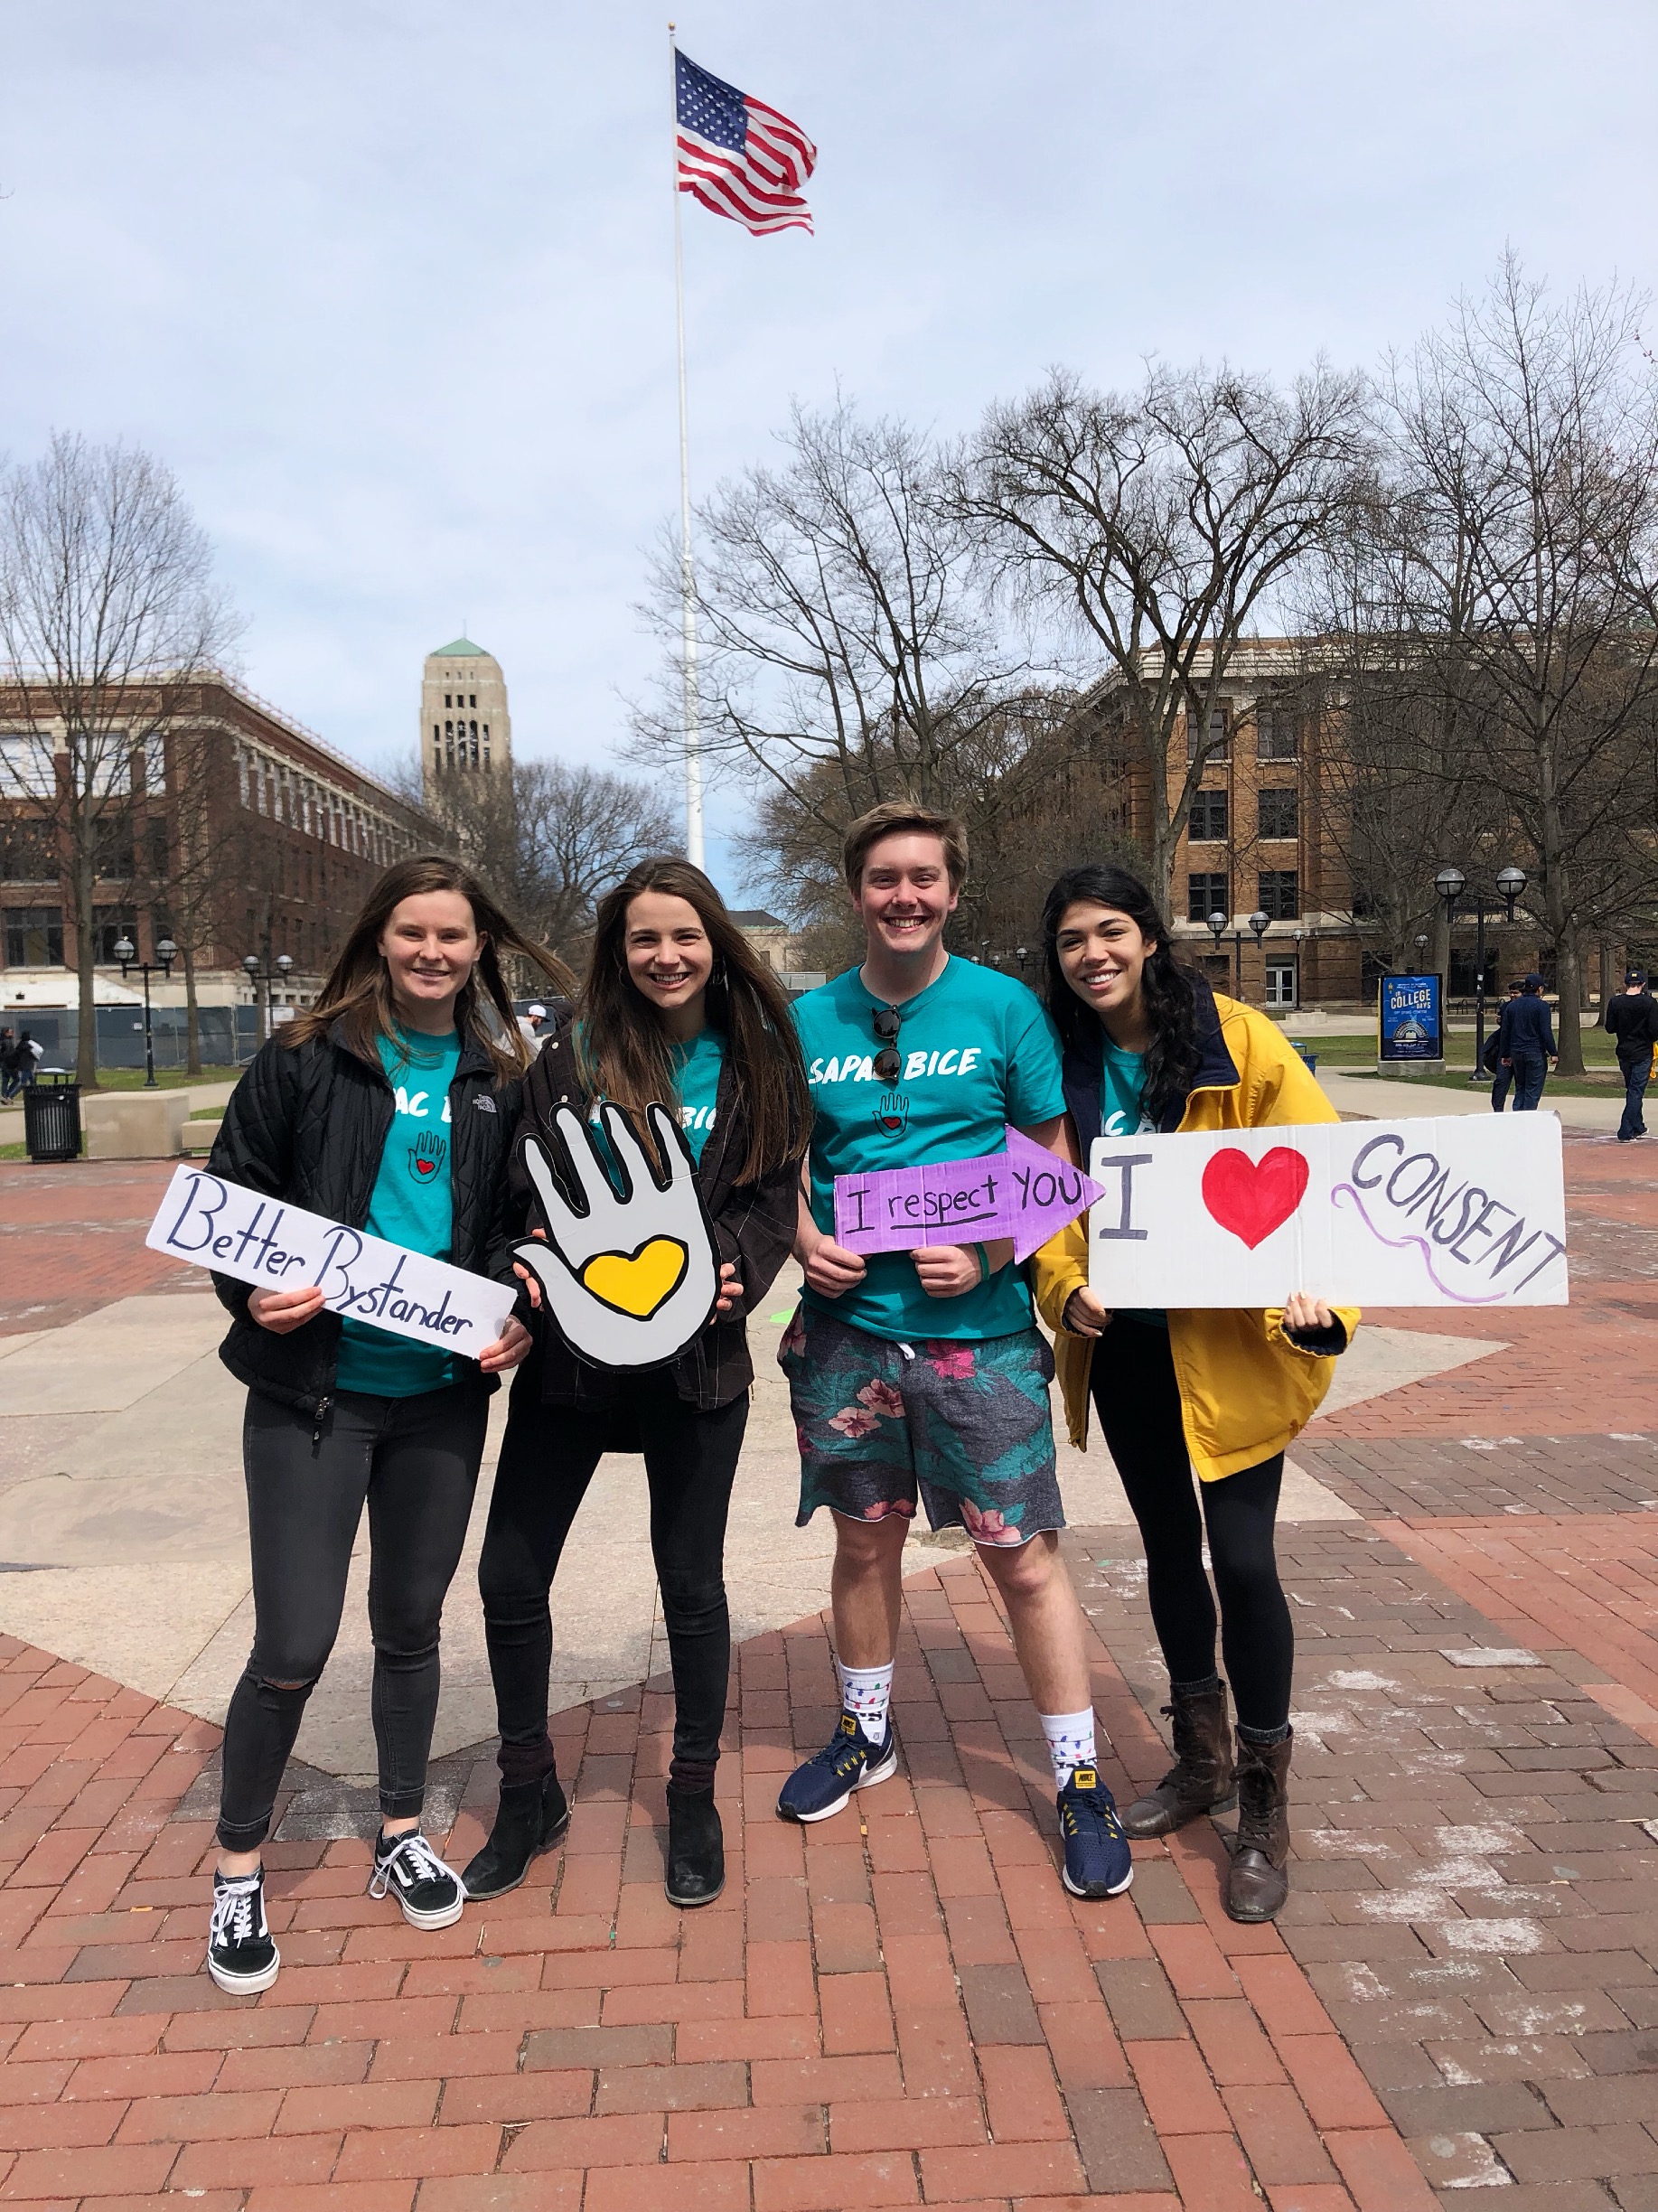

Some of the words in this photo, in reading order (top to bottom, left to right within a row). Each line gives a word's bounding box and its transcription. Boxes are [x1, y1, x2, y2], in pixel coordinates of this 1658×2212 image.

[1391, 989, 1430, 1009] COLLEGE
[808, 1055, 886, 1084] SAPA
[904, 1047, 981, 1080] BICE
[845, 1189, 875, 1234] I
[888, 1175, 998, 1223] respect
[1012, 1167, 1082, 1211] YOU
[1099, 1153, 1153, 1240] I
[1351, 1133, 1567, 1294] CONSENT
[167, 1173, 306, 1277] Better
[314, 1225, 473, 1336] Bystander
